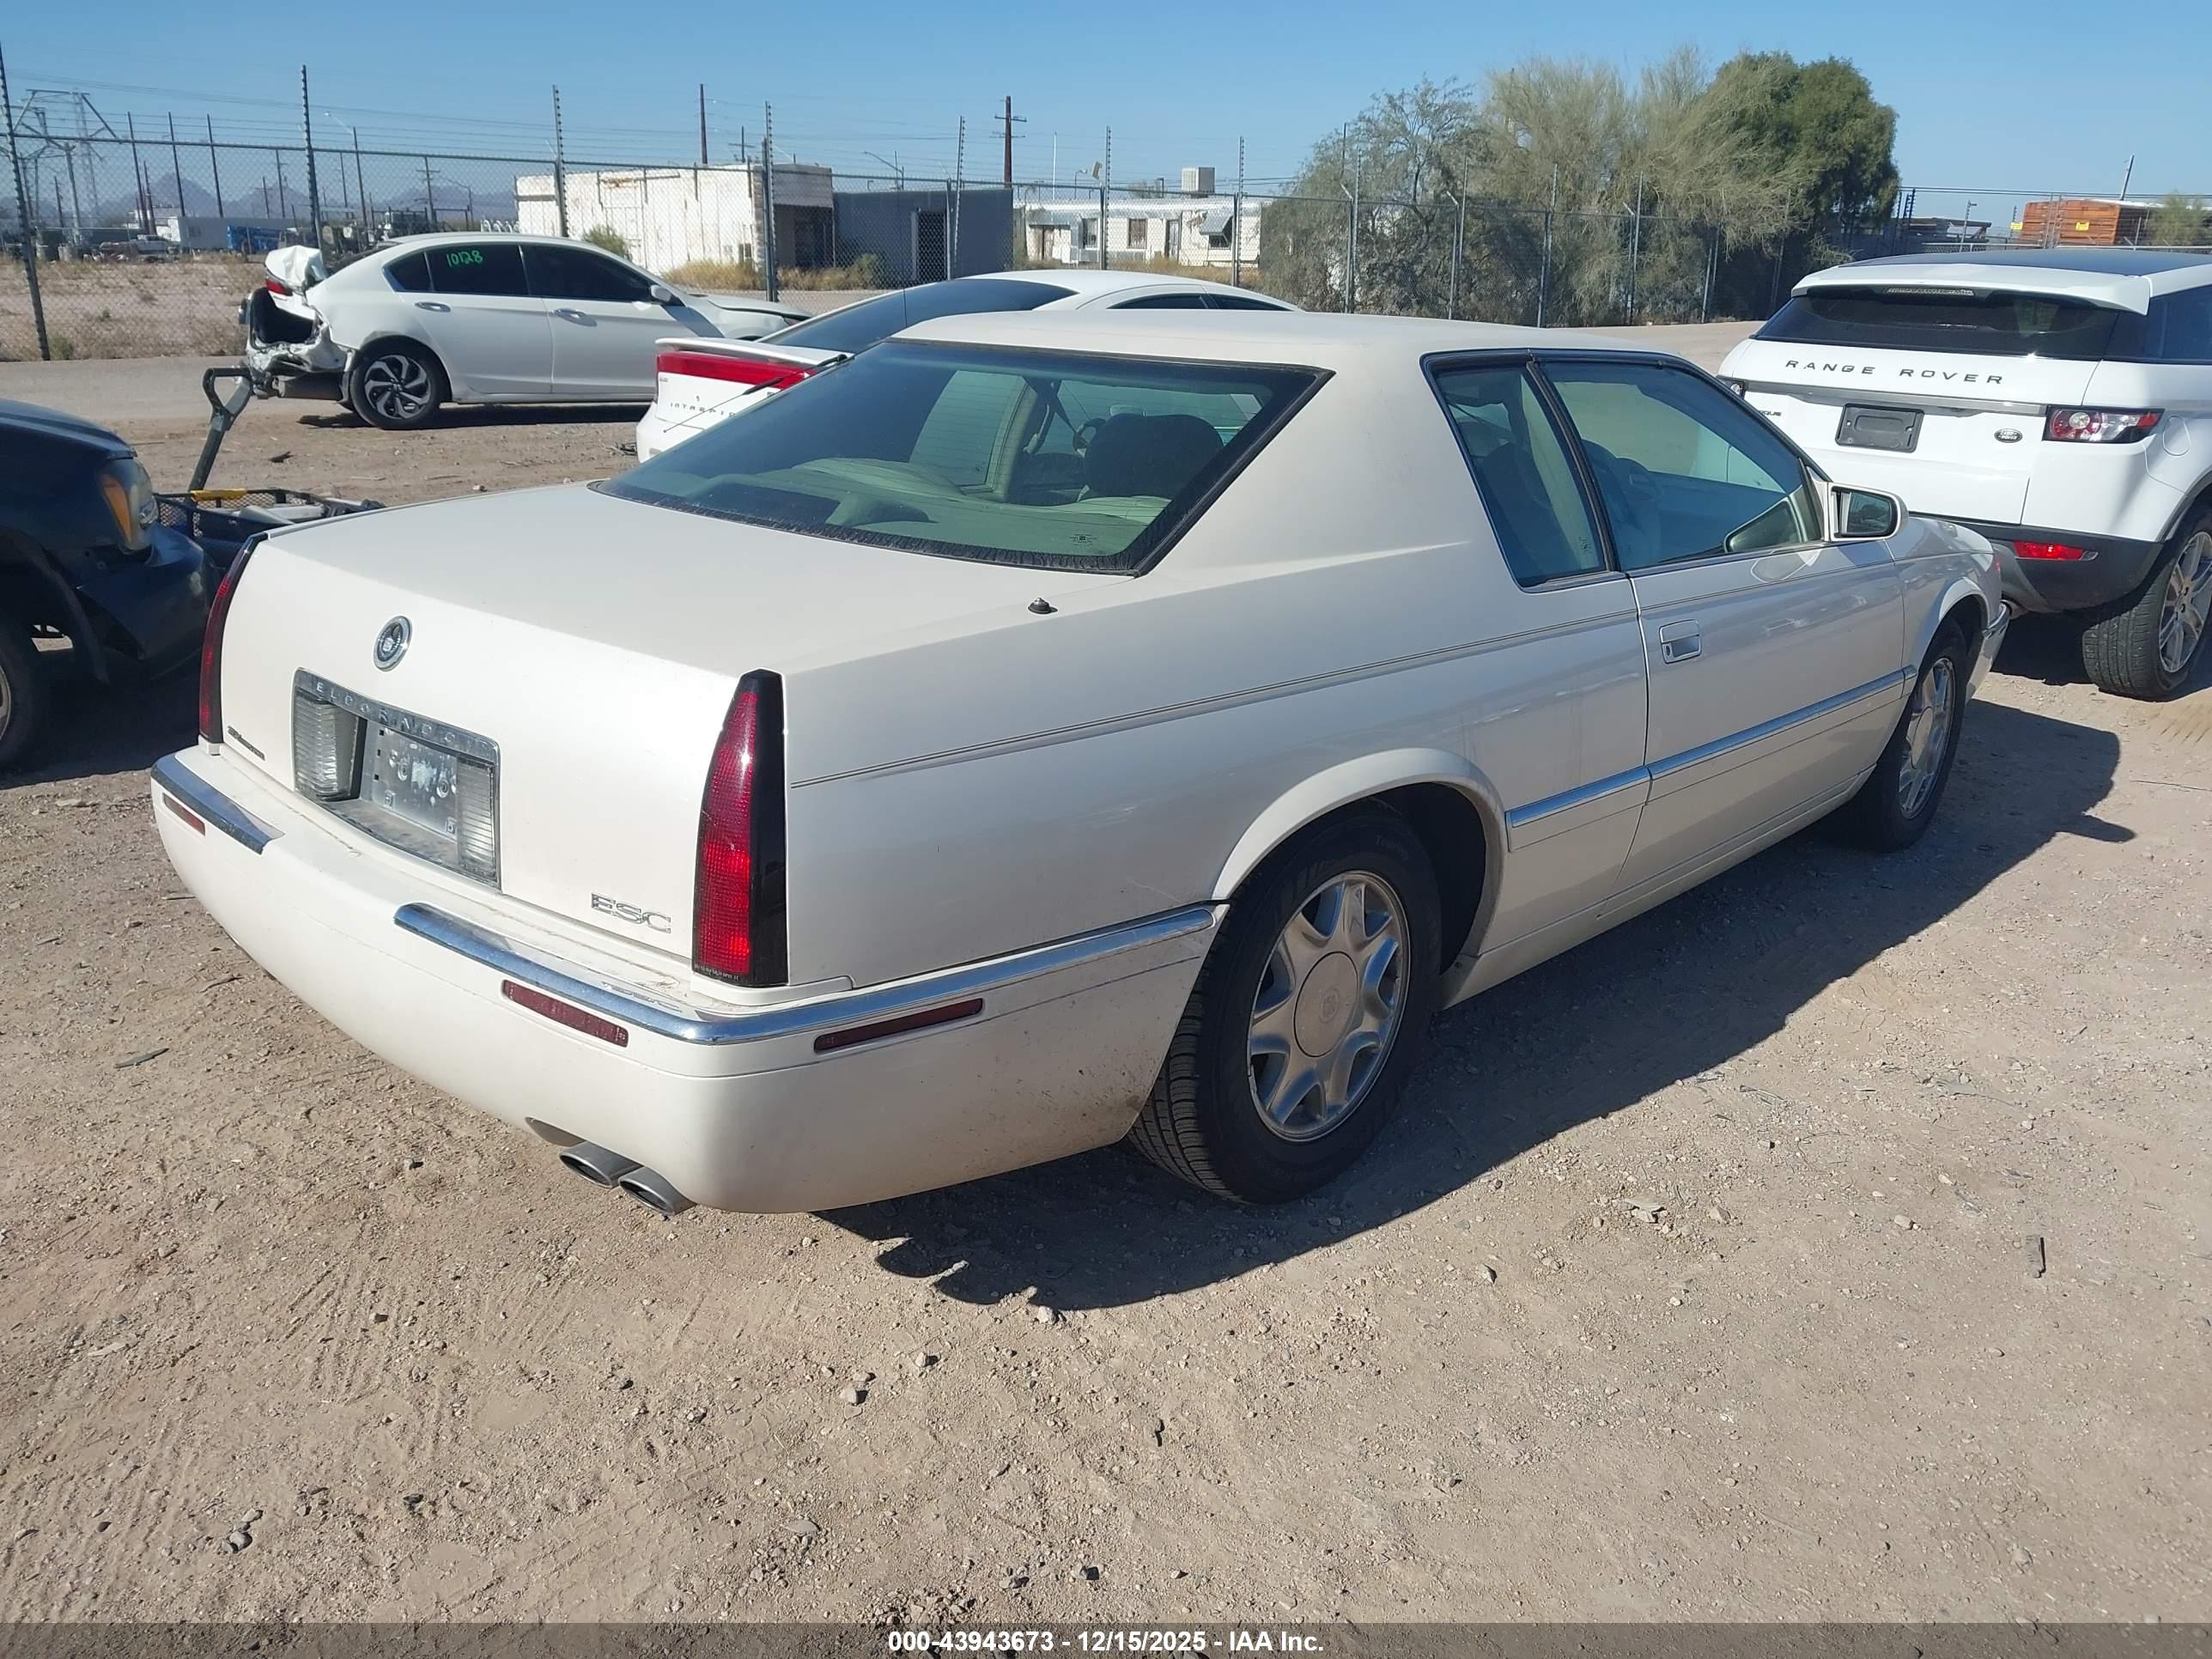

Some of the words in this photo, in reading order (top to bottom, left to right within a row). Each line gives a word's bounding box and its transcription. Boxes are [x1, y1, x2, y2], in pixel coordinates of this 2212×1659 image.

[1785, 360, 1875, 375] RANGE
[1899, 368, 2002, 385] ROVER
[316, 682, 455, 743] ELDORADO
[591, 893, 672, 934] ESC
